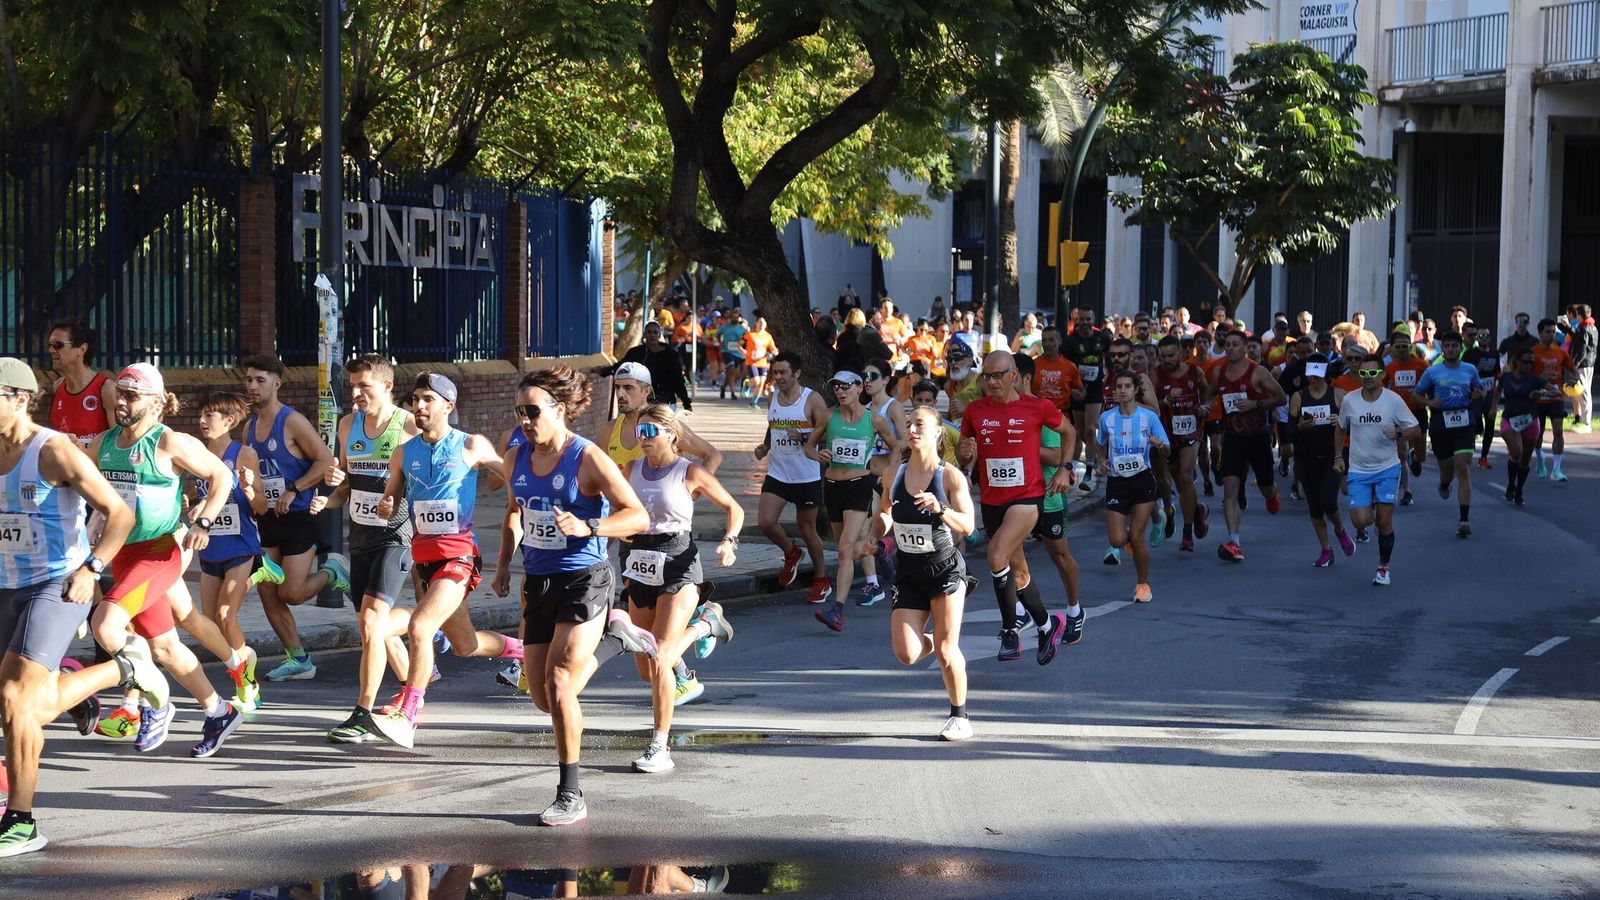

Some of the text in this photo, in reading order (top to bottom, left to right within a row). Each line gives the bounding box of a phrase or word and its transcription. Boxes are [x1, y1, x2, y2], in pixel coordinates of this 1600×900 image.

[1300, 2, 1349, 18] CORNER VIP
[1300, 15, 1348, 30] MALAGUISTA
[1311, 411, 1326, 419] 58
[1359, 412, 1382, 424] nike
[1175, 421, 1192, 429] 787
[836, 446, 859, 457] 828
[1118, 461, 1139, 471] 938
[991, 468, 1017, 478] 882
[264, 488, 280, 499] 36
[354, 502, 378, 516] 754
[211, 515, 233, 527] 49
[420, 511, 455, 523] 1030
[0, 528, 22, 541] 47
[528, 522, 557, 538] 752
[900, 533, 925, 546] 110
[631, 561, 657, 576] 464
